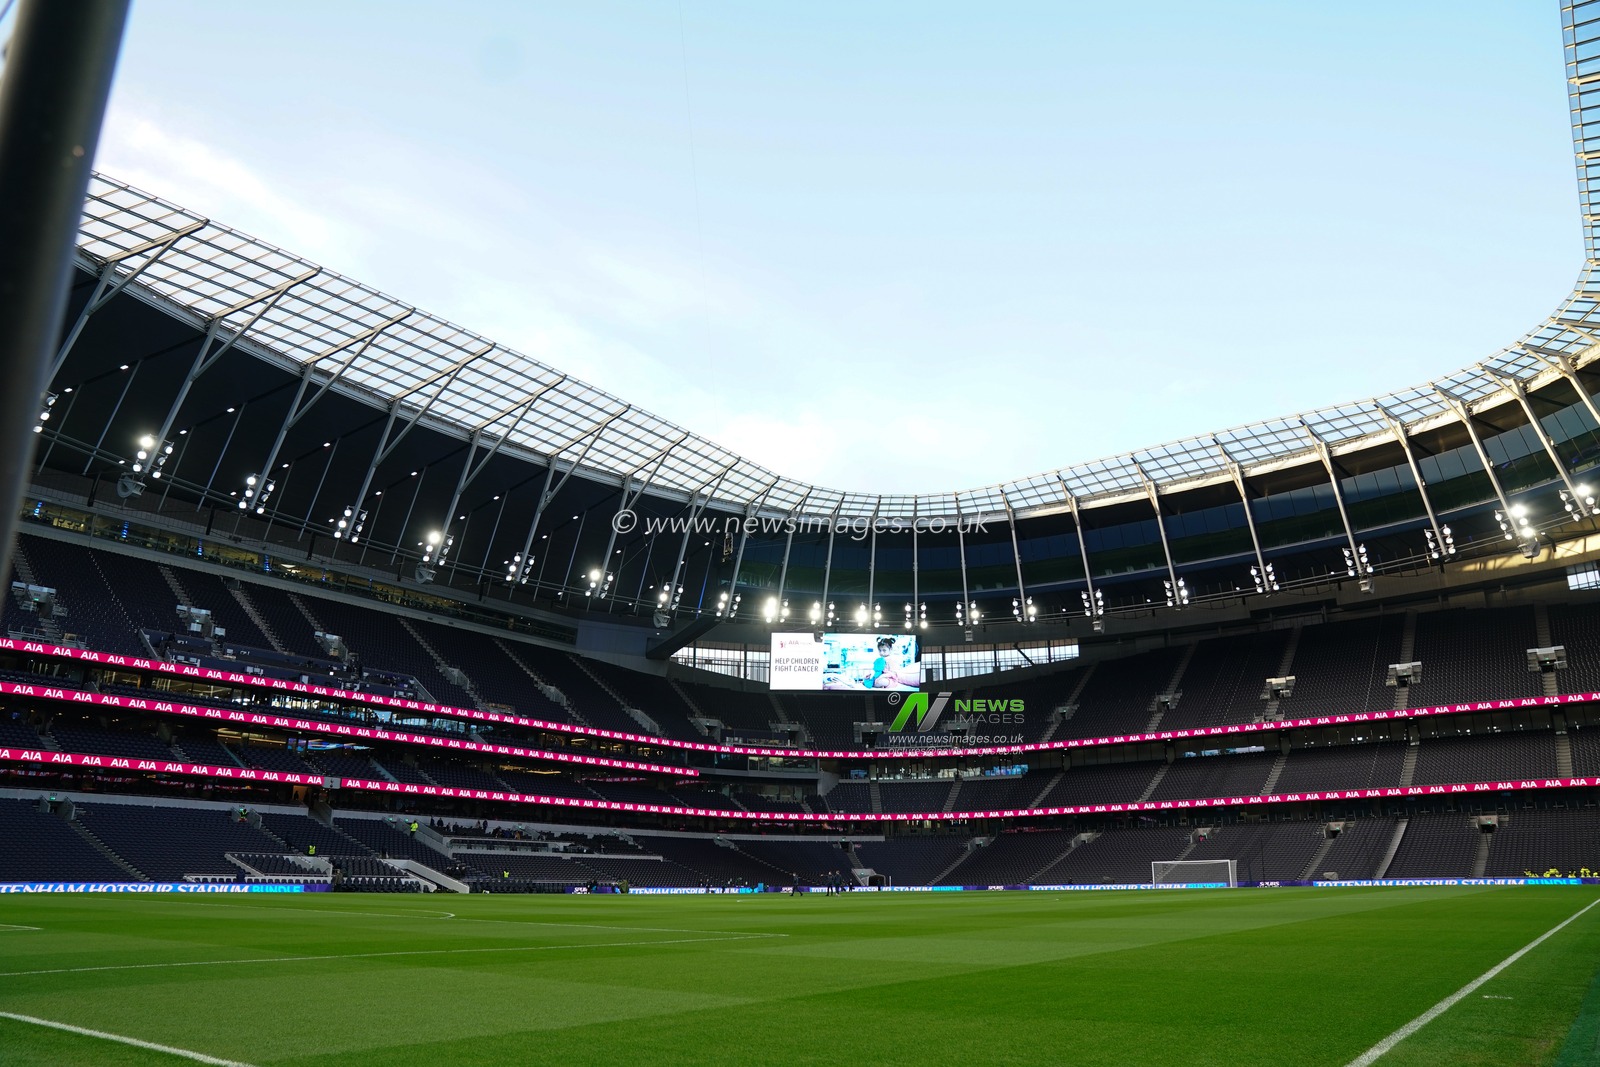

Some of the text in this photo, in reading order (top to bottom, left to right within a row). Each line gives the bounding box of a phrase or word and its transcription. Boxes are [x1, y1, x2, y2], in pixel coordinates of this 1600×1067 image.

[24, 642, 43, 652] AIA
[53, 647, 71, 656] AIA
[81, 651, 98, 660] AIA
[108, 655, 124, 664] AIA
[134, 659, 150, 668] AIA
[160, 663, 175, 672] AIA
[184, 667, 198, 676] AIA
[207, 670, 222, 680] AIA
[230, 674, 244, 682] AIA
[252, 677, 265, 686] AIA
[14, 685, 33, 694] AIA
[44, 689, 63, 698] AIA
[74, 692, 92, 702] AIA
[102, 696, 119, 706] AIA
[129, 699, 146, 708] AIA
[156, 702, 172, 712] AIA
[182, 706, 197, 714] AIA
[206, 709, 221, 718] AIA
[230, 712, 244, 720] AIA
[253, 715, 266, 724] AIA
[275, 718, 288, 726] AIA
[338, 726, 350, 735] AIA
[21, 751, 41, 760] AIA
[53, 753, 72, 764] AIA
[82, 756, 101, 766] AIA
[111, 758, 129, 768] AIA
[139, 761, 156, 770] AIA
[166, 763, 182, 772] AIA
[192, 765, 207, 774] AIA
[216, 768, 232, 776] AIA
[240, 770, 255, 778] AIA
[264, 772, 278, 780] AIA
[286, 774, 300, 782] AIA
[308, 776, 321, 784] AIA
[87, 884, 173, 892] HOTSPUR
